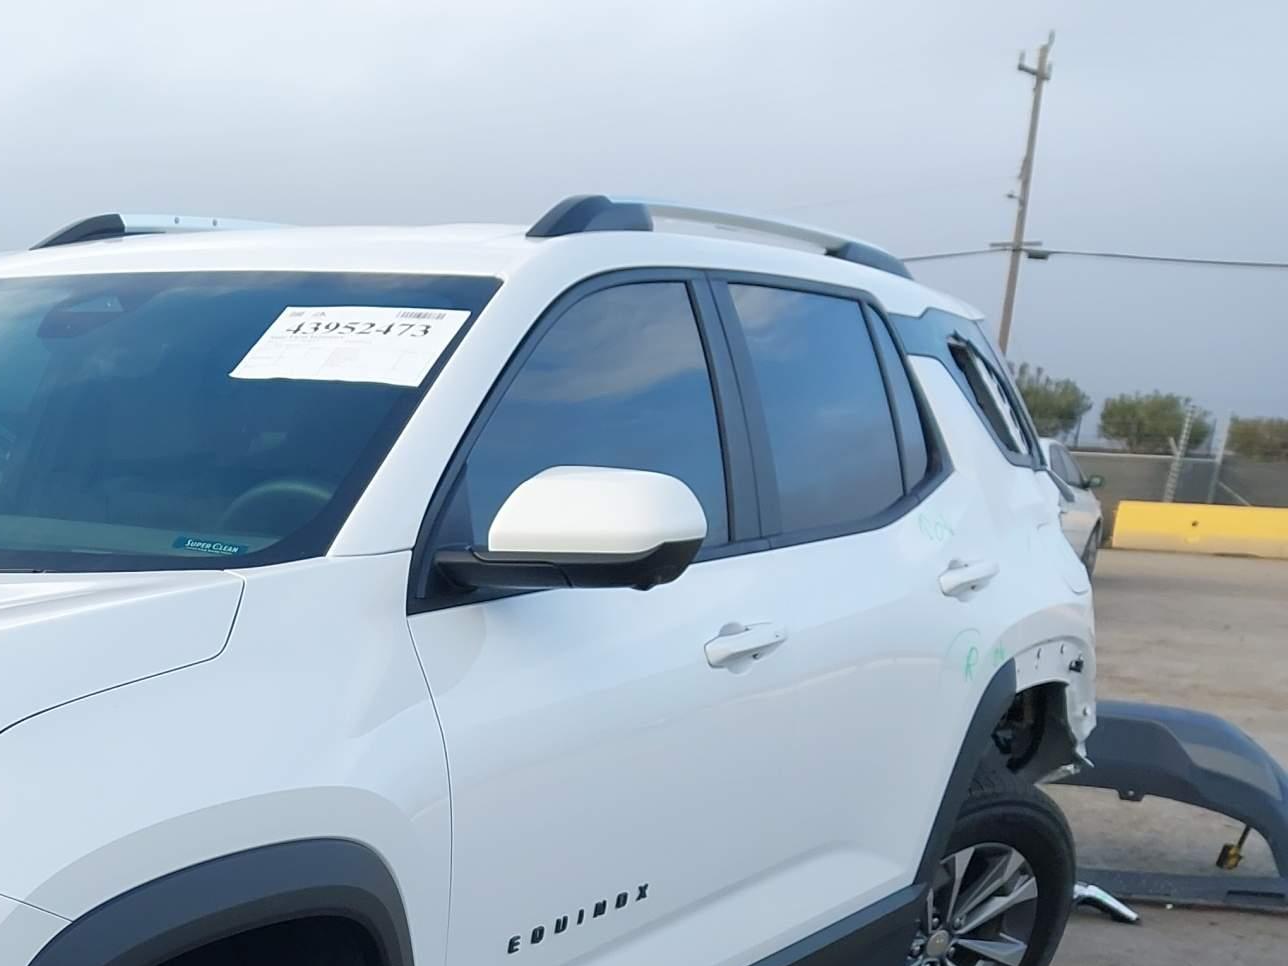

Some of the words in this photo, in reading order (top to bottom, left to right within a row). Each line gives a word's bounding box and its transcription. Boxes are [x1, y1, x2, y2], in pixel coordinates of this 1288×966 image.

[285, 320, 432, 338] 43952473
[184, 539, 211, 549] SUPER
[212, 543, 240, 553] CLEAN
[507, 882, 650, 954] EQUINOX
